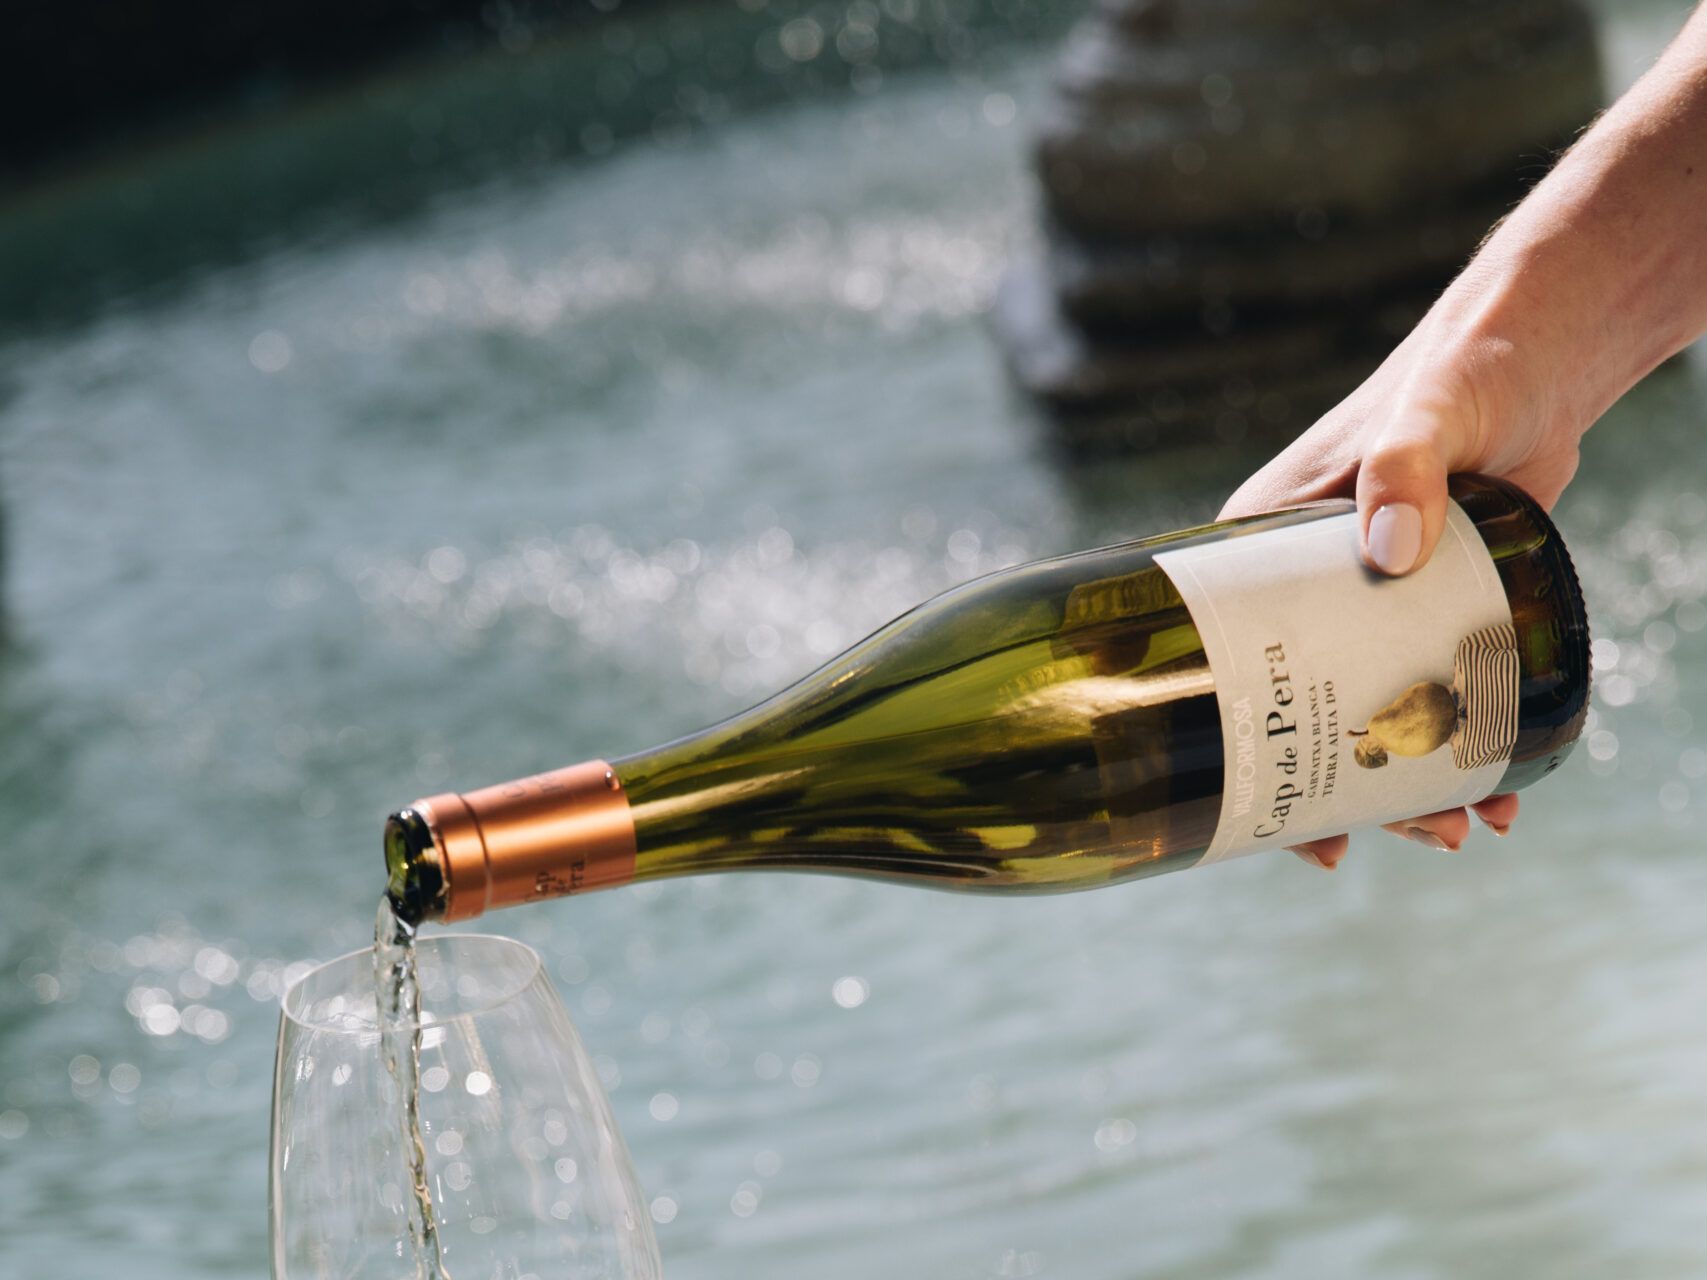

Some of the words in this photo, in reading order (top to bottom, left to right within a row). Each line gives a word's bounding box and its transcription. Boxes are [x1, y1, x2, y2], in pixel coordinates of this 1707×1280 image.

[1265, 642, 1298, 741] Pera
[1309, 685, 1321, 735] BLANCA
[1324, 680, 1337, 704] DO
[1324, 710, 1338, 747] ALTA
[1232, 697, 1257, 819] VALLFORMOSA
[1276, 748, 1298, 775] de
[1308, 739, 1321, 798] GARNATXA
[1322, 750, 1338, 797] TERRA
[1253, 783, 1304, 839] Cap
